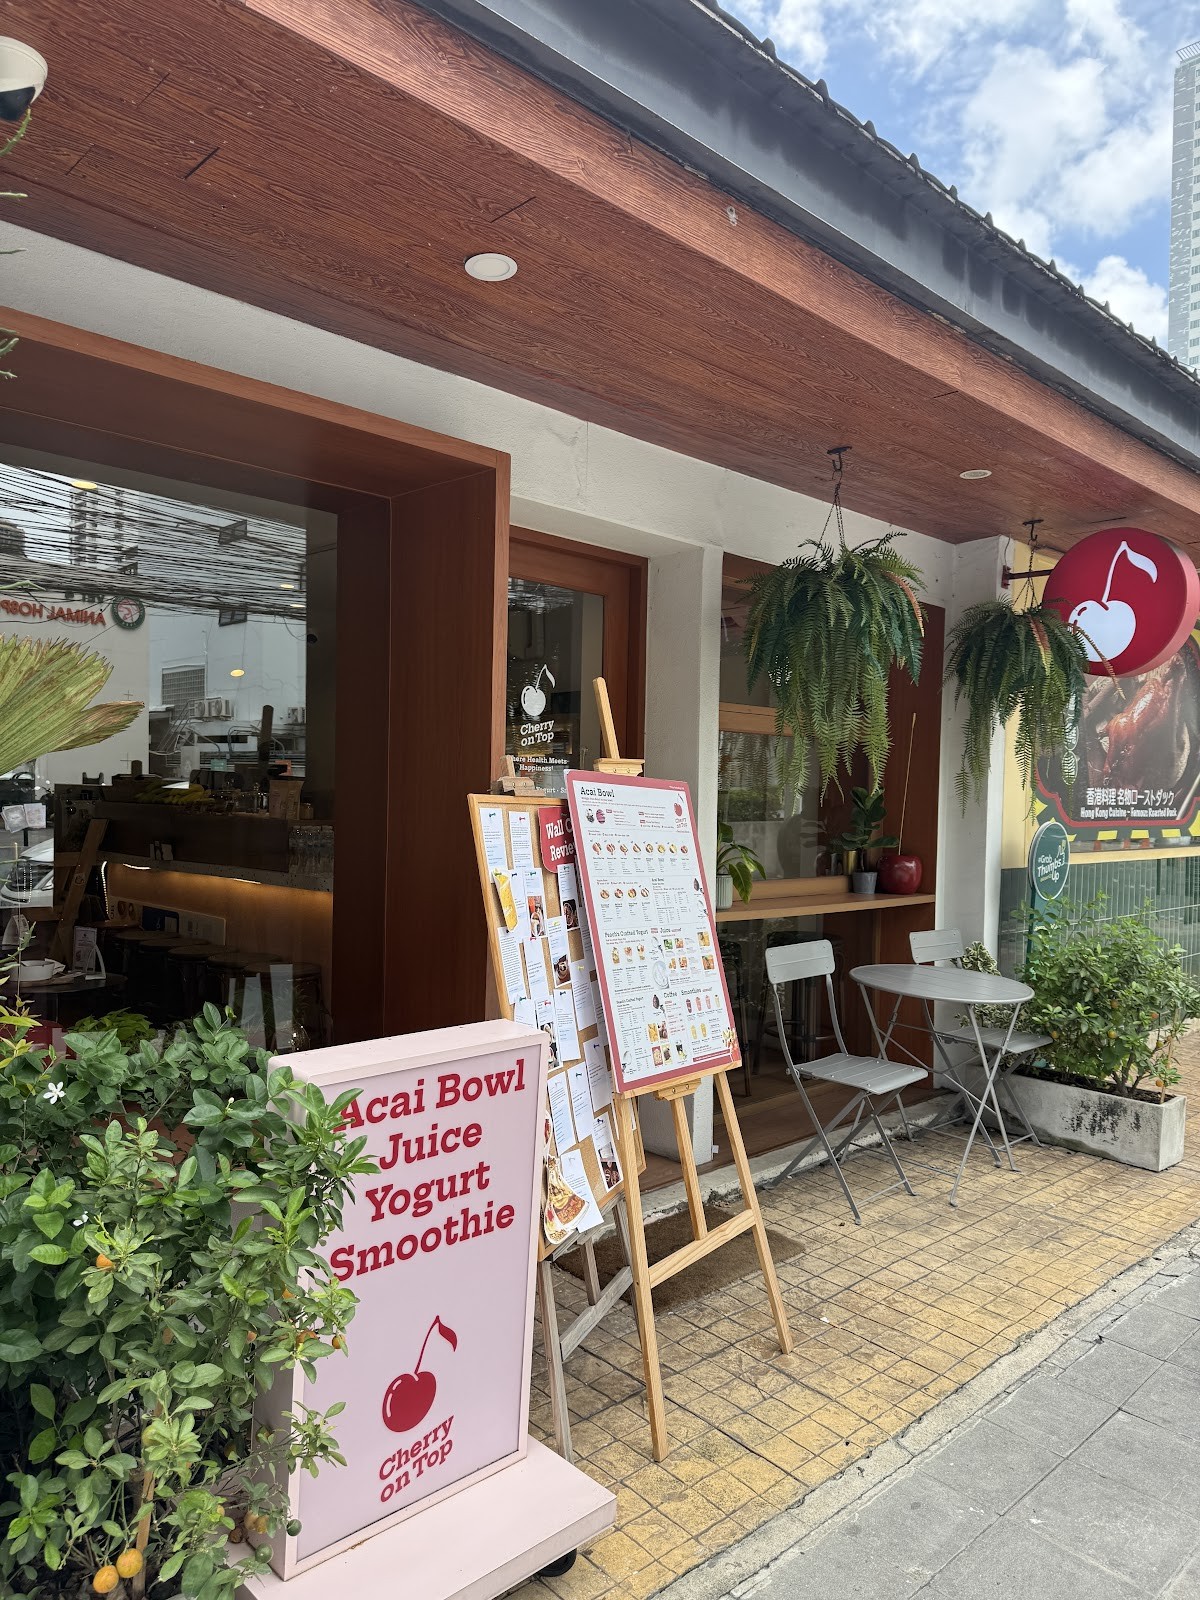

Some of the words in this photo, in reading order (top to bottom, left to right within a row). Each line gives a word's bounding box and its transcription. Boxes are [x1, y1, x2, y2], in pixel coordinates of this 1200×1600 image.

[520, 720, 554, 735] Cherry
[521, 736, 535, 747] on
[535, 731, 554, 746] Top
[520, 764, 554, 772] Happiness!
[549, 757, 567, 765] Meets
[580, 787, 596, 797] Acai
[597, 788, 615, 798] Bowl
[1087, 787, 1116, 806] 香港料理
[1117, 788, 1175, 806] 名物ローストダック
[1081, 807, 1094, 819] Hong
[1095, 807, 1108, 819] Kong
[1109, 807, 1127, 817] Cuisine
[1131, 807, 1148, 817] Famous
[1148, 808, 1166, 817] Roasted
[1166, 808, 1177, 817] Duck
[545, 819, 565, 840] Wall
[550, 839, 577, 862] Revie
[1037, 858, 1061, 877] Thumbs
[1051, 871, 1060, 883] Up
[334, 1079, 425, 1133] Acai
[436, 1058, 525, 1109] Bowl
[379, 1121, 482, 1170] Juice
[365, 1161, 491, 1223] Yogurt
[330, 1201, 515, 1282] Smoothie
[379, 1415, 454, 1481] Cherry
[380, 1474, 410, 1503] on
[413, 1439, 453, 1478] Top
